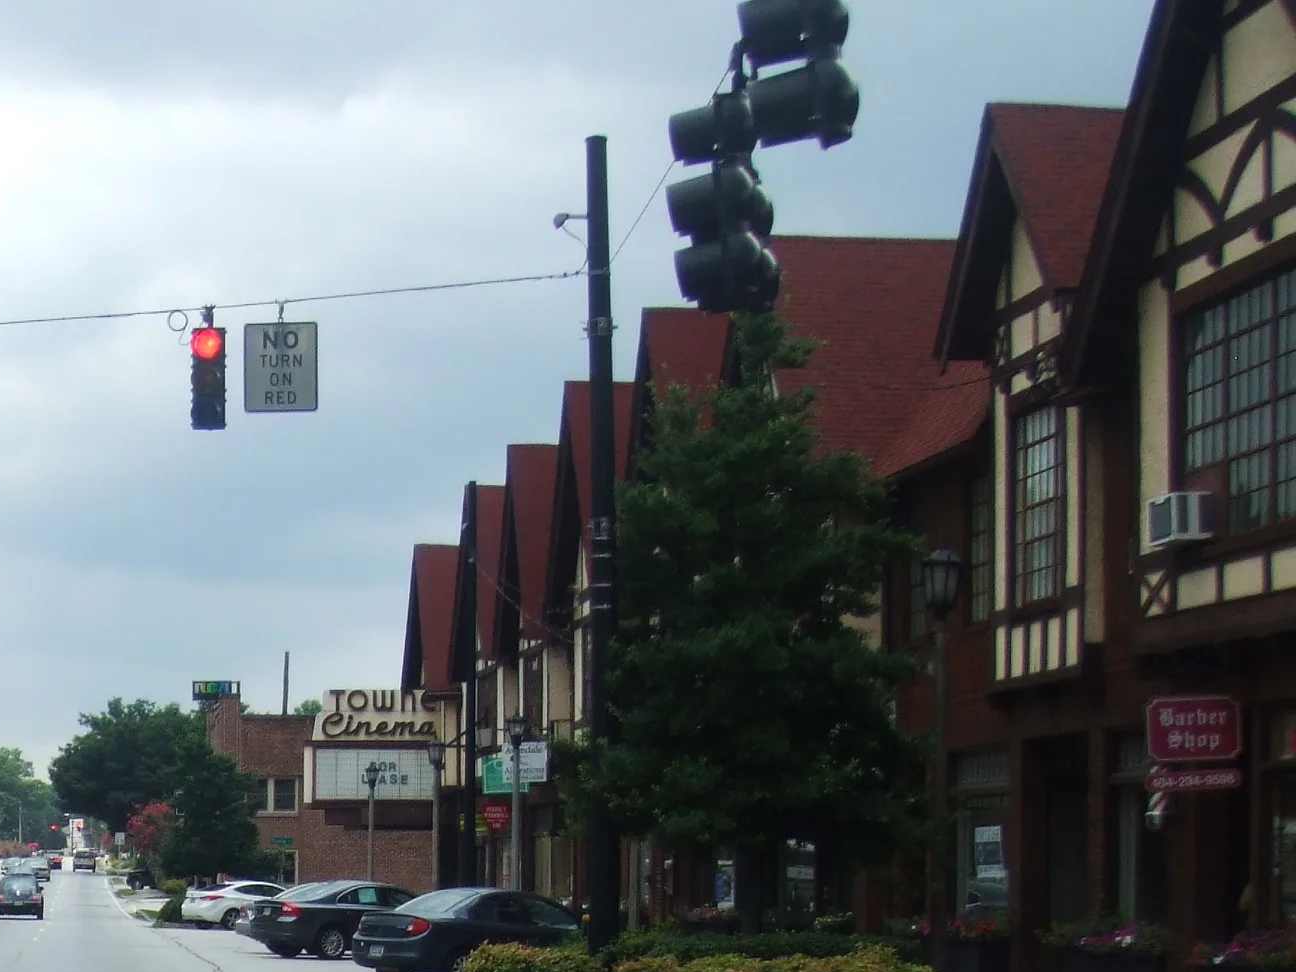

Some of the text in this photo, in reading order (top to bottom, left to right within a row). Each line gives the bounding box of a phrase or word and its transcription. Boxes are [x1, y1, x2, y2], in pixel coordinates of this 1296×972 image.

[262, 331, 299, 349] NO
[260, 354, 303, 368] TURN
[270, 372, 292, 386] ON
[265, 391, 298, 405] RED
[322, 712, 437, 737] Cinema
[1159, 708, 1226, 726] Barber
[1168, 730, 1220, 751] Shop
[362, 774, 408, 784] LASE
